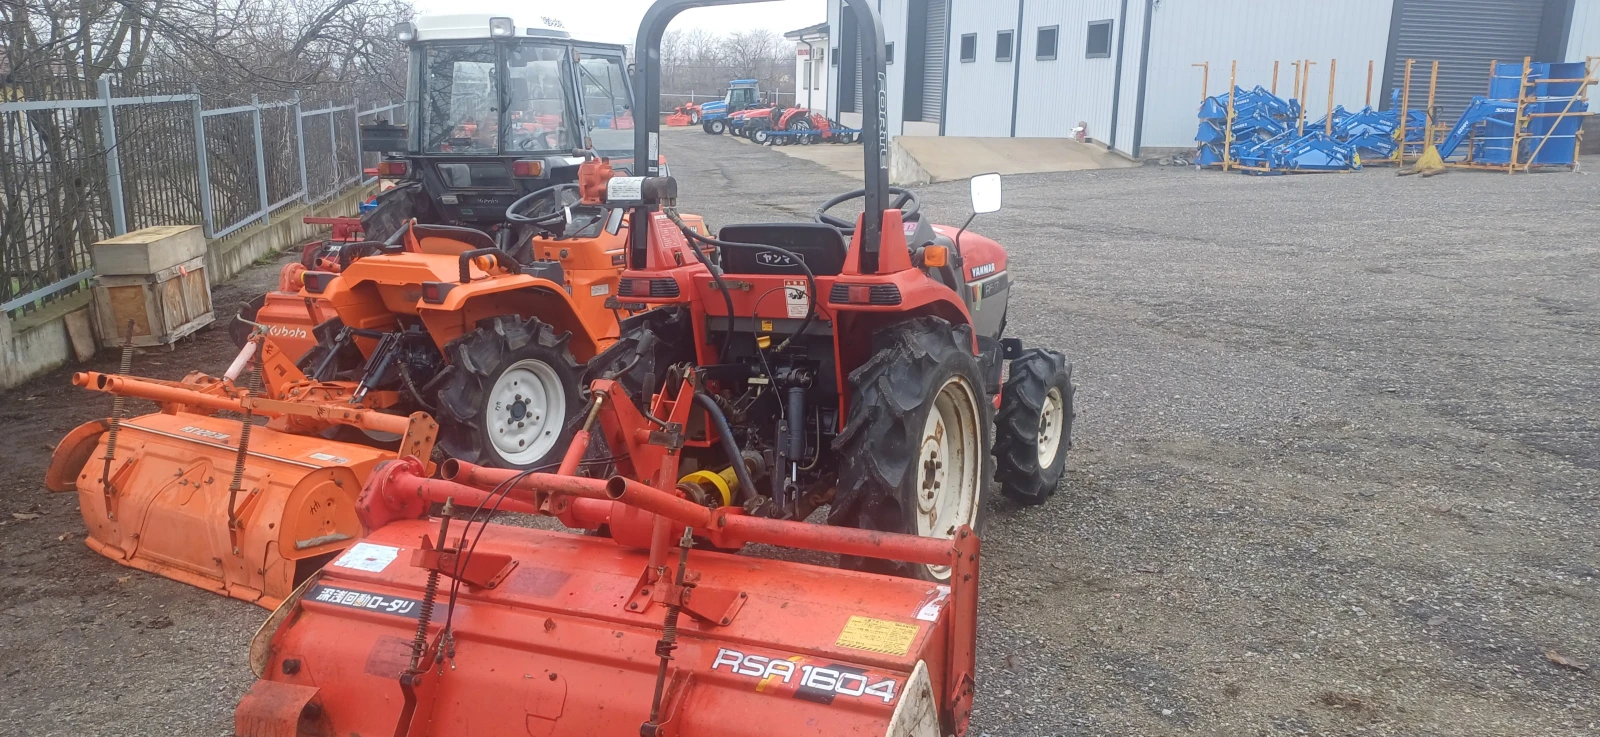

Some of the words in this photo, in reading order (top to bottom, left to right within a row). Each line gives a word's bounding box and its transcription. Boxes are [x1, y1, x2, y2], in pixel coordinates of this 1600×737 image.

[877, 71, 889, 170] FORTE
[762, 253, 791, 264] ヤンマ
[971, 262, 996, 278] YANMAR
[267, 324, 307, 339] Kubota
[711, 647, 796, 684] RSA
[799, 664, 898, 703] 1604
